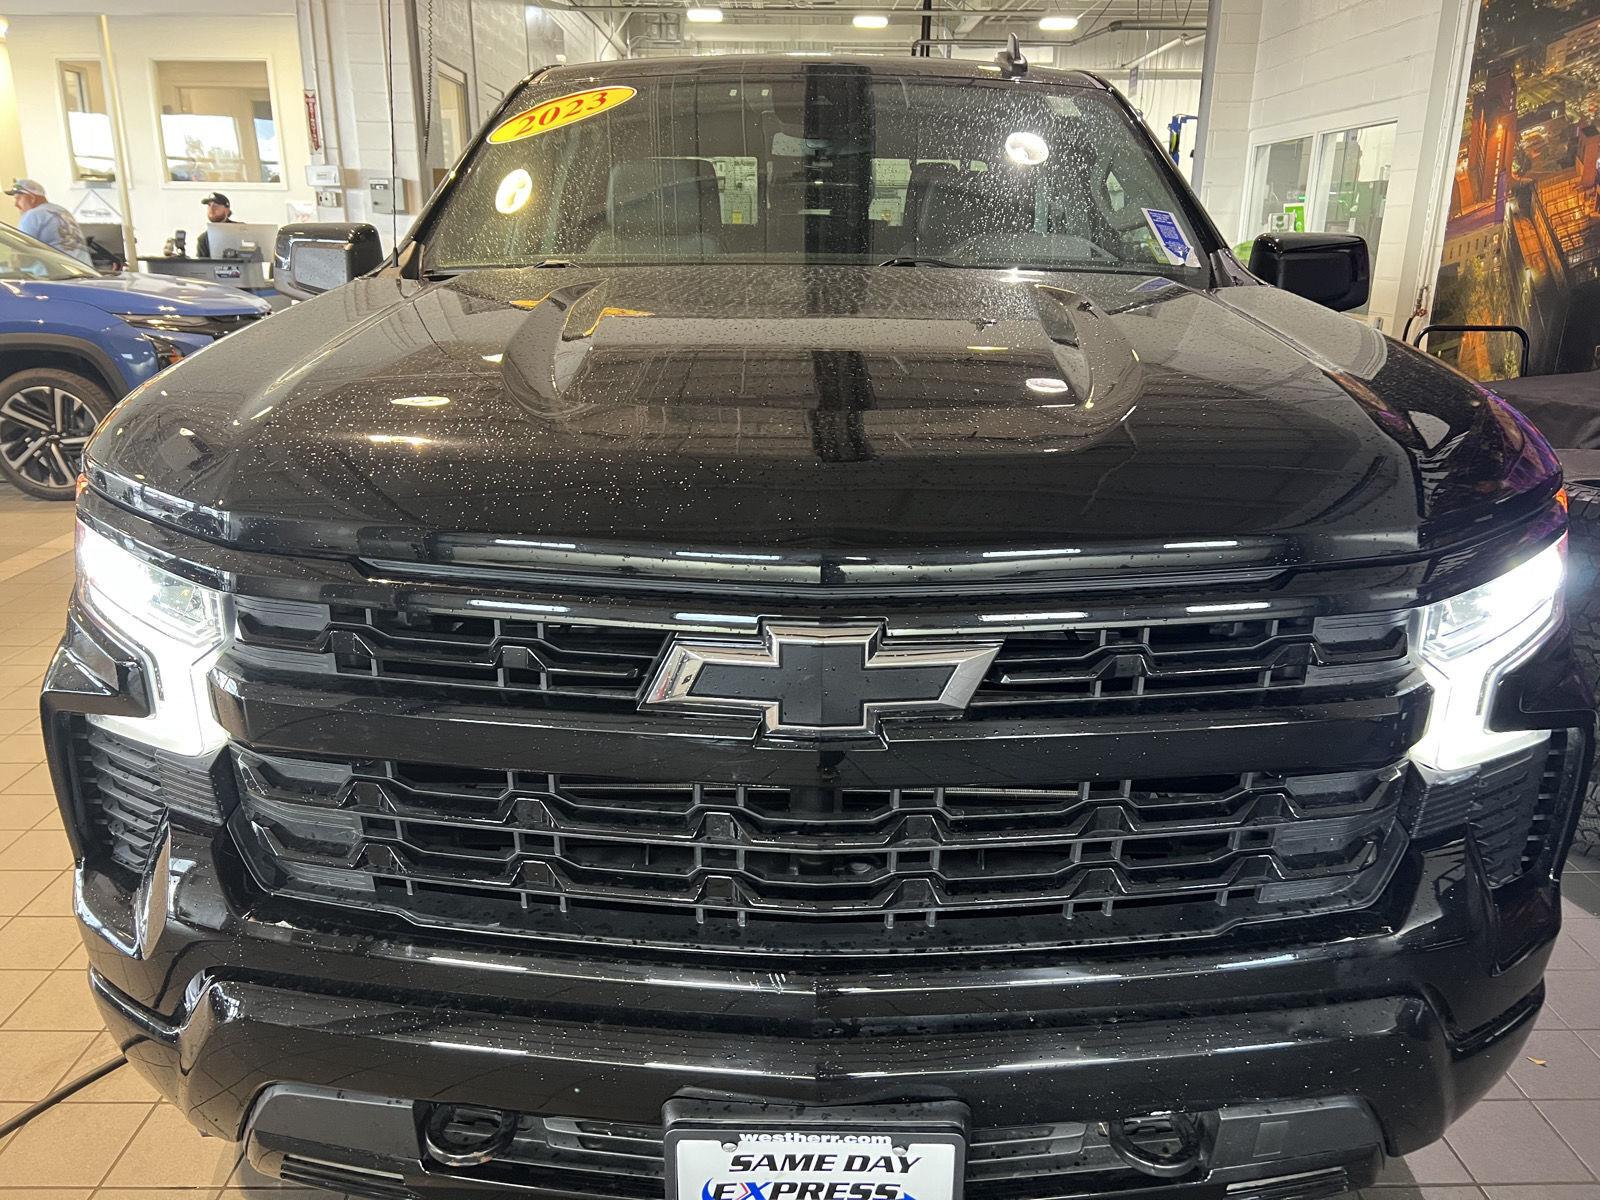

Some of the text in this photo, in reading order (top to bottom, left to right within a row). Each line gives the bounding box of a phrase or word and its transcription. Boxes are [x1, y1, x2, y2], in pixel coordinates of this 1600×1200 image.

[514, 92, 608, 137] 2023
[739, 1132, 892, 1145] westherr.com
[729, 1154, 922, 1173] SAME DAY
[712, 1181, 901, 1200] EXPRESS
